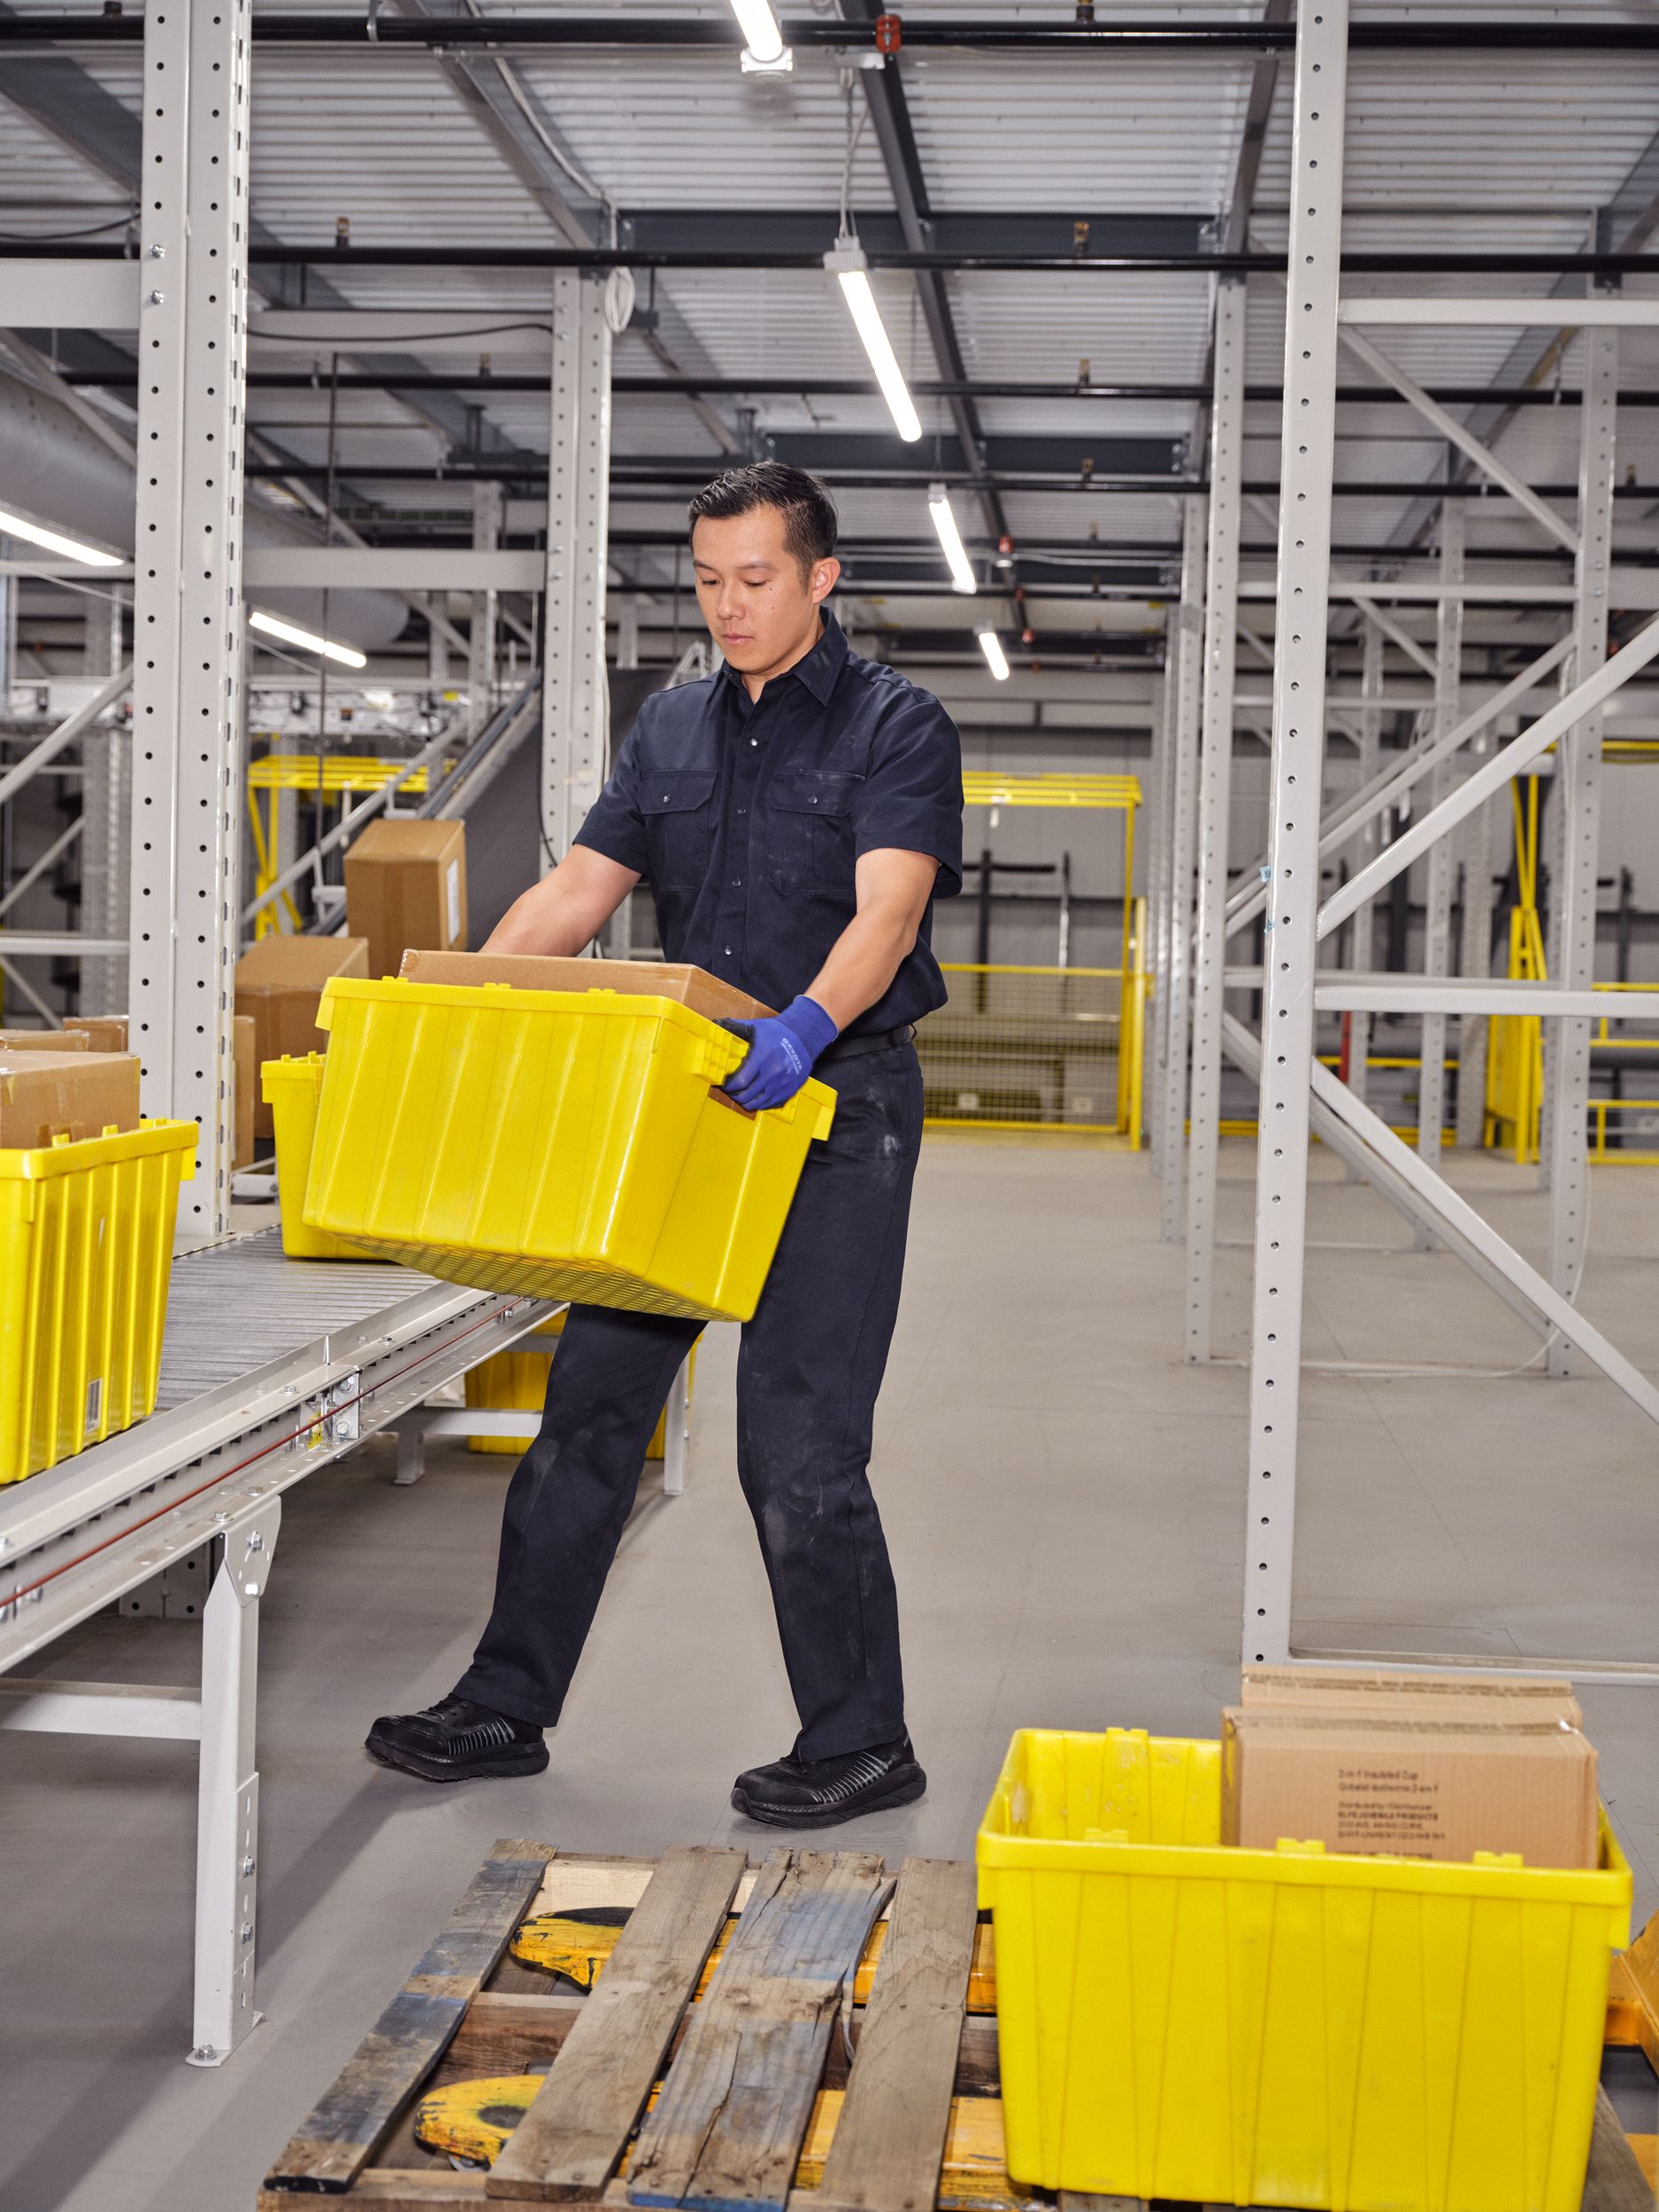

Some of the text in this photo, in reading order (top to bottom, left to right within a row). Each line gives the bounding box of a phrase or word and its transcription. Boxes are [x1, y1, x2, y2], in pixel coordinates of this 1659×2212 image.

[782, 1037, 803, 1071] DAKOTA
[1363, 1770, 1400, 1780] Insulated
[1402, 1770, 1418, 1782] Cup
